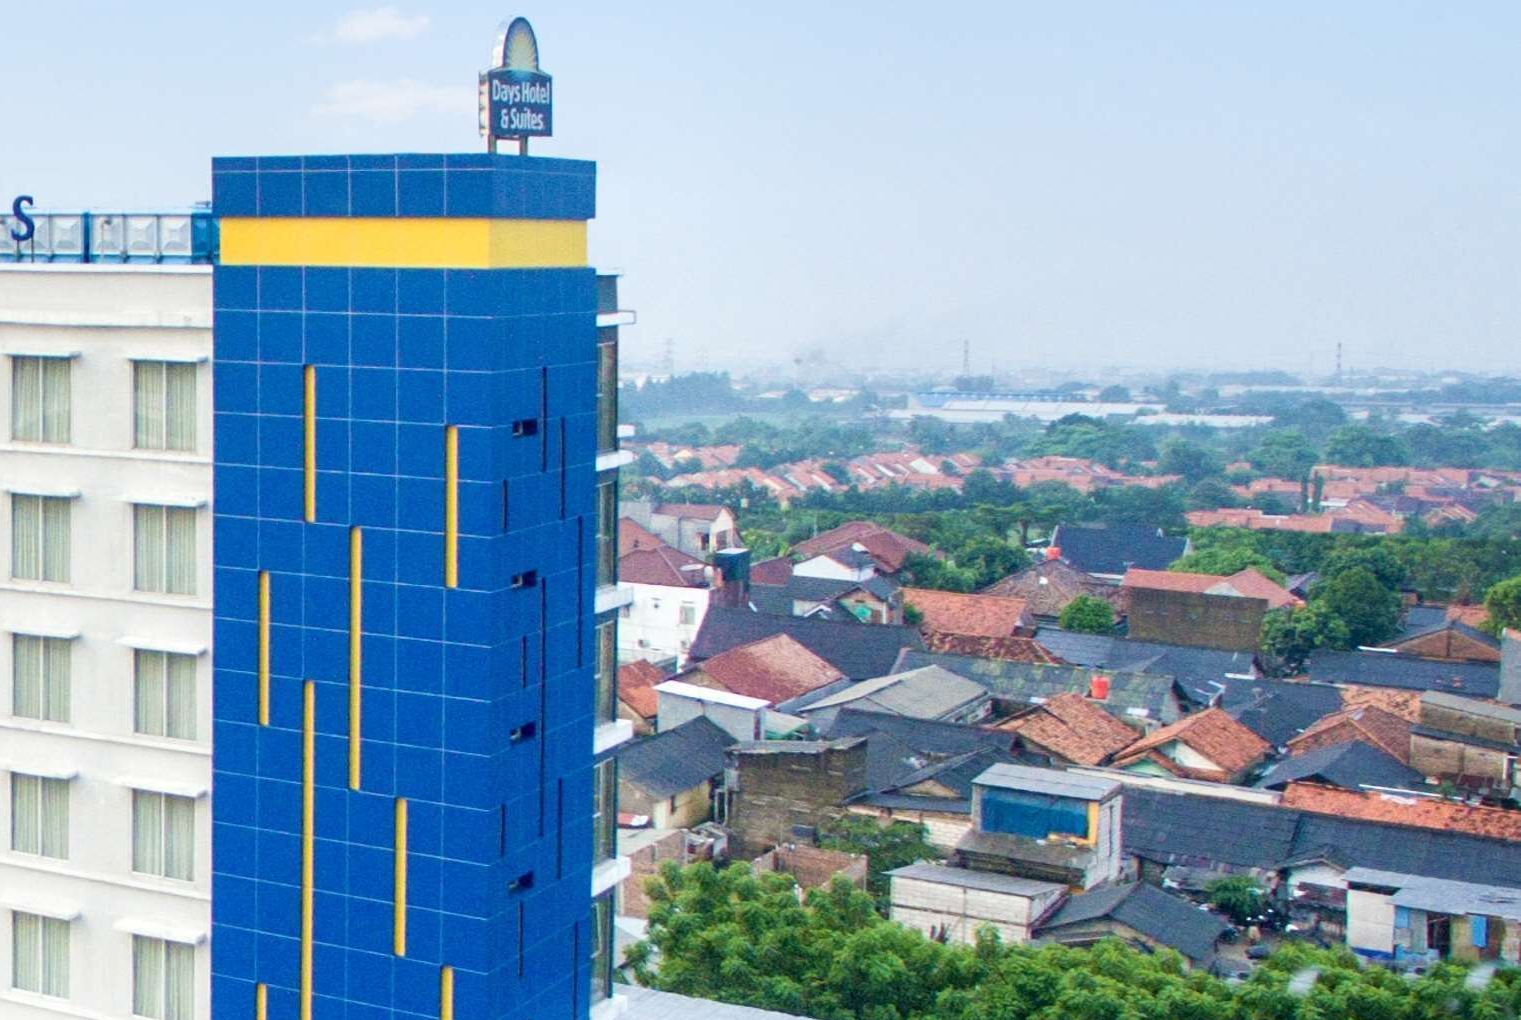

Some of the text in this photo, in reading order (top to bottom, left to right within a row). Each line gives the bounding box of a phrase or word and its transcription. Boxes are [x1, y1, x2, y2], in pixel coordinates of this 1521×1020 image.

[492, 79, 550, 105] Days Hotel
[500, 106, 544, 130] & Suites
